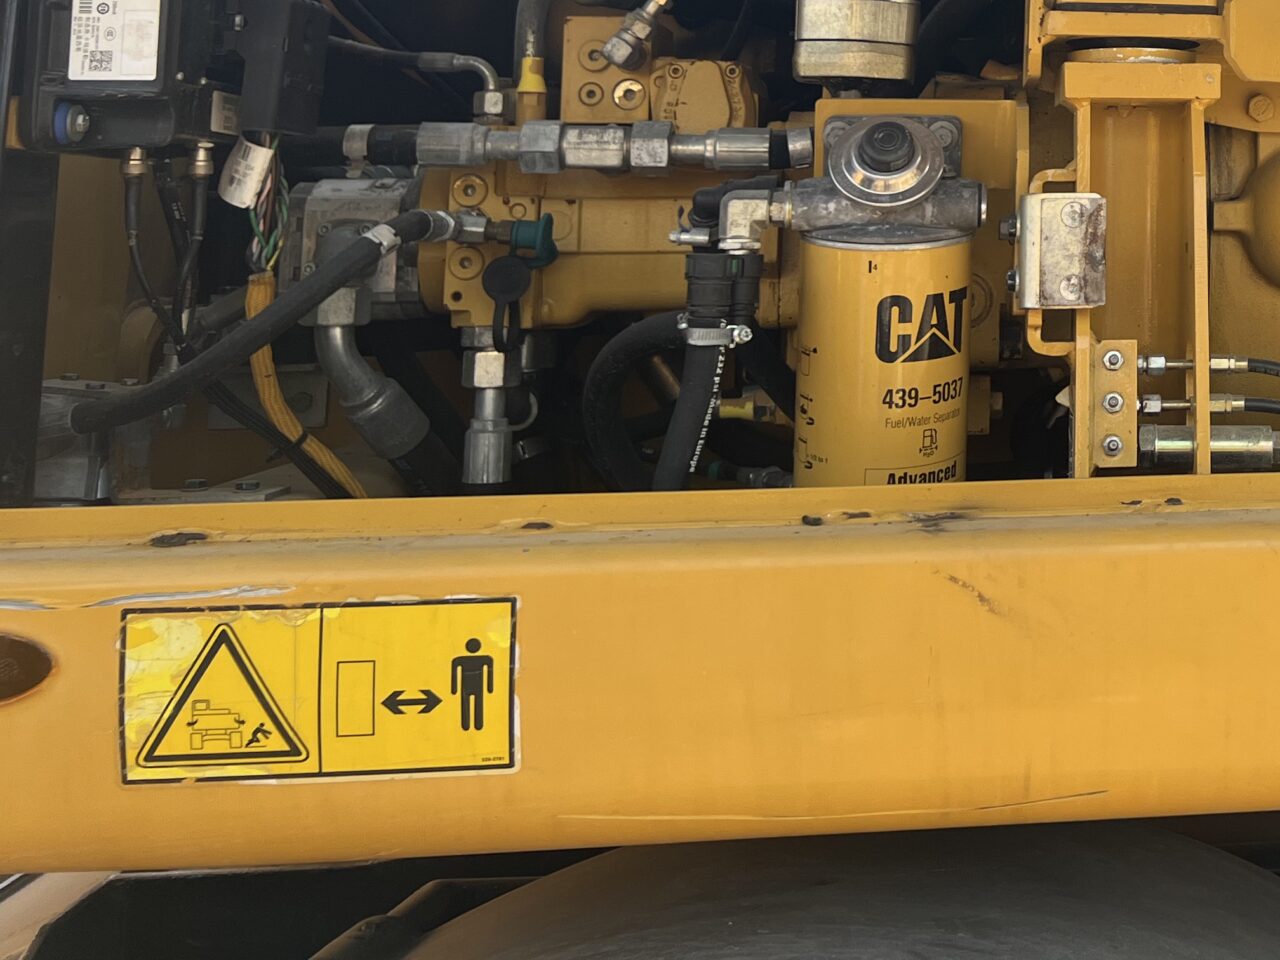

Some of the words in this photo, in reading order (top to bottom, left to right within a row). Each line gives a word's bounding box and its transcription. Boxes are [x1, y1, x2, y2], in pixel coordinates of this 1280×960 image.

[875, 286, 968, 364] CAT
[716, 354, 726, 375] 232
[885, 416, 931, 429] Fuel/Water
[689, 440, 705, 472] Europe
[887, 460, 957, 485] Advanced
